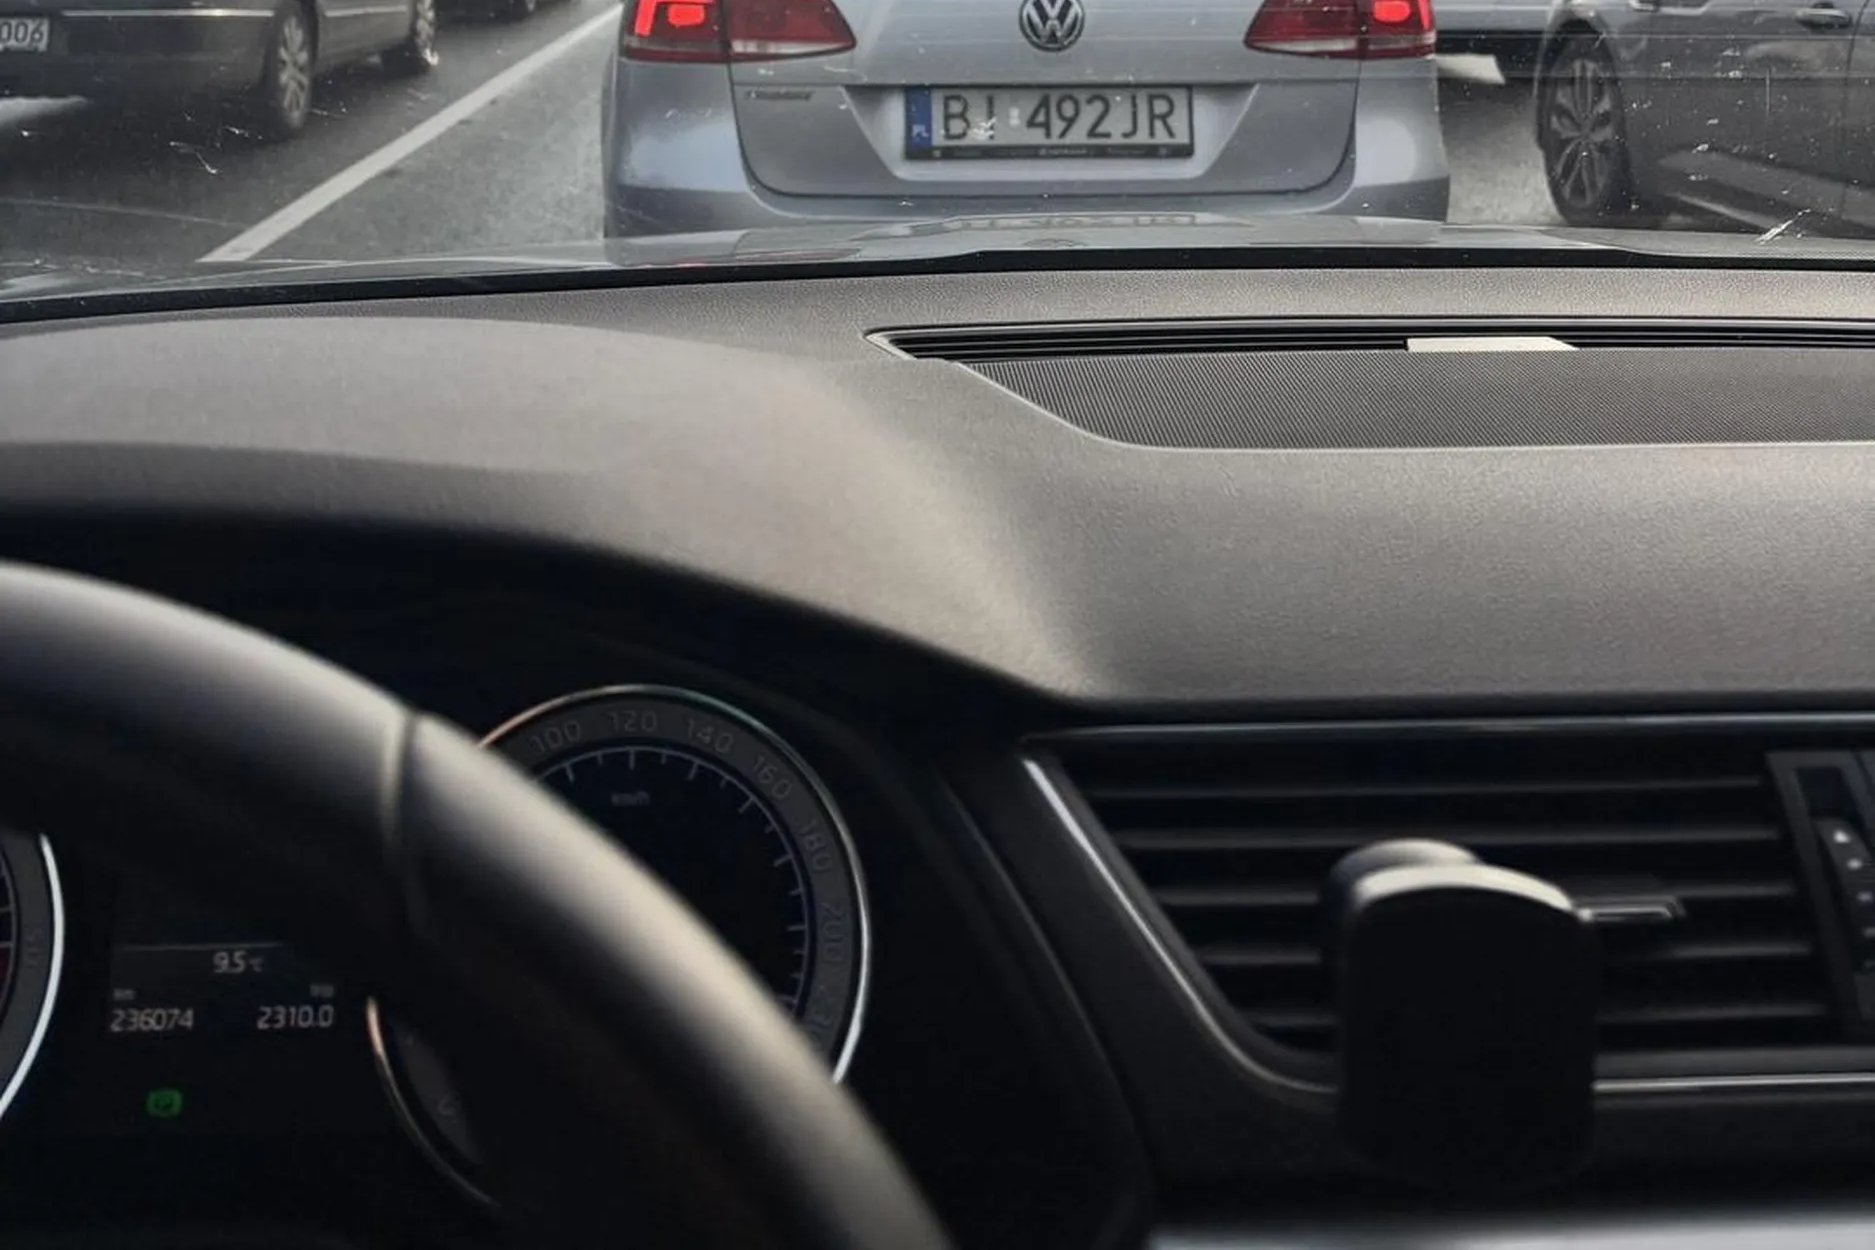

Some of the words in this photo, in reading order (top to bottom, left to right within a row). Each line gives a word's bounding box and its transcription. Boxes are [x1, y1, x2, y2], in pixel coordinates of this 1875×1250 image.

[1026, 94, 1175, 140] 492JR
[608, 711, 659, 733] 120
[687, 718, 735, 755] 140
[752, 755, 794, 801] 160
[111, 1007, 195, 1032] 236074
[256, 1005, 335, 1030] 2310.0
